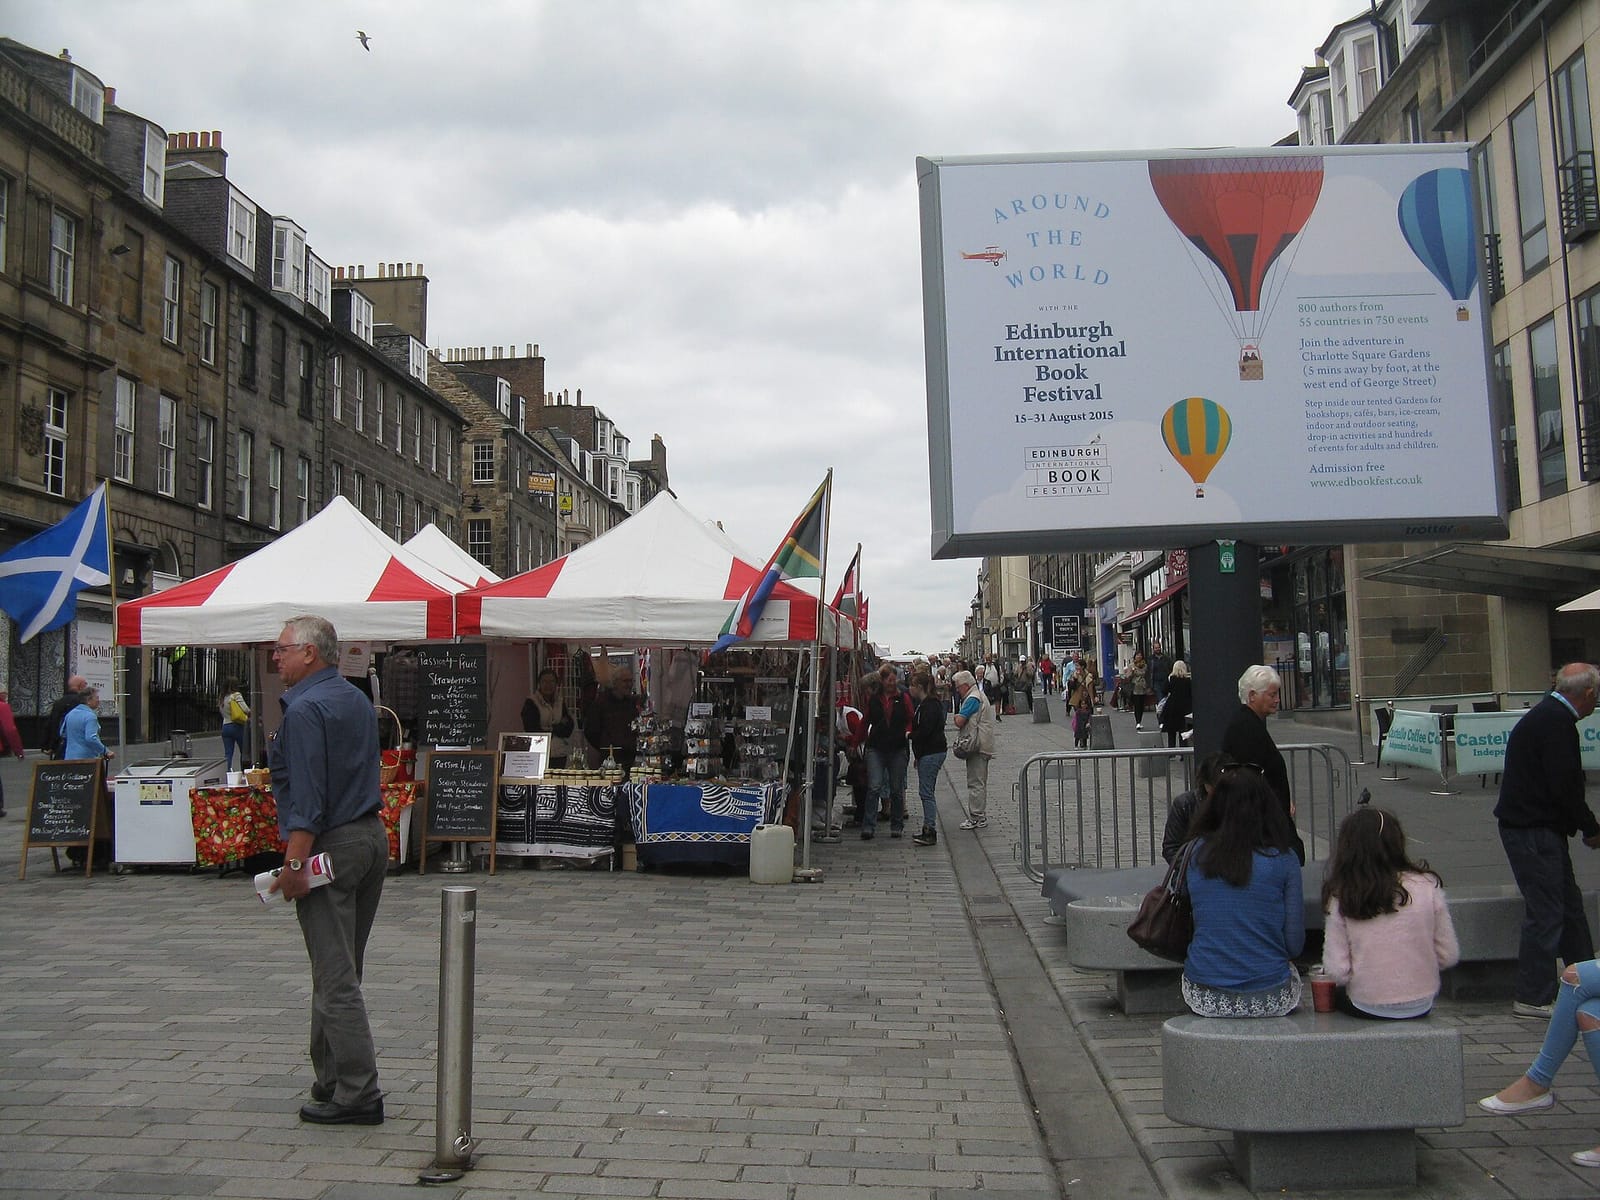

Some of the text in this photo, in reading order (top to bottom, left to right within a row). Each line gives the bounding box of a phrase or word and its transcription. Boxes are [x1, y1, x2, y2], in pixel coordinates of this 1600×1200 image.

[994, 194, 1110, 224] AROUND
[1026, 230, 1082, 248] THE
[1005, 264, 1109, 289] WORLD
[1298, 302, 1384, 313] 800 authors from
[1300, 316, 1429, 327] 55 countries in 750 events
[1005, 321, 1114, 342] Edinburgh
[1300, 336, 1405, 350] Join the adventure in
[994, 341, 1126, 362] International
[1302, 349, 1431, 362] Charlotte Square Gardens
[1036, 364, 1088, 381] Book
[1302, 362, 1440, 377] (5 mins away by foot, at the
[1304, 376, 1437, 390] west end of George Street)
[1023, 384, 1103, 402] Festival
[1305, 400, 1323, 409] Step
[1325, 398, 1349, 407] inside
[1395, 397, 1428, 405] Gardens
[1049, 412, 1086, 424] August
[1089, 411, 1114, 420] 2015
[1306, 410, 1352, 420] bookshops,
[1378, 408, 1398, 417] bars,
[1400, 408, 1441, 416] ice-cream,
[1306, 420, 1418, 430] indoor and outdoor seating,
[1307, 430, 1433, 442] drop-in activities and hundreds
[1308, 444, 1318, 452] of
[1346, 442, 1358, 452] for
[1360, 442, 1384, 450] adults
[1386, 442, 1401, 450] and
[1403, 440, 1439, 449] children.
[1032, 448, 1100, 458] EDINBURGH
[1309, 462, 1385, 474] Admission free
[1048, 470, 1101, 483] BOOK
[1310, 475, 1422, 488] www.edbookfest.co.uk
[1033, 486, 1102, 496] FESTIVAL
[1406, 525, 1456, 535] trotter
[1407, 729, 1426, 743] Coffee
